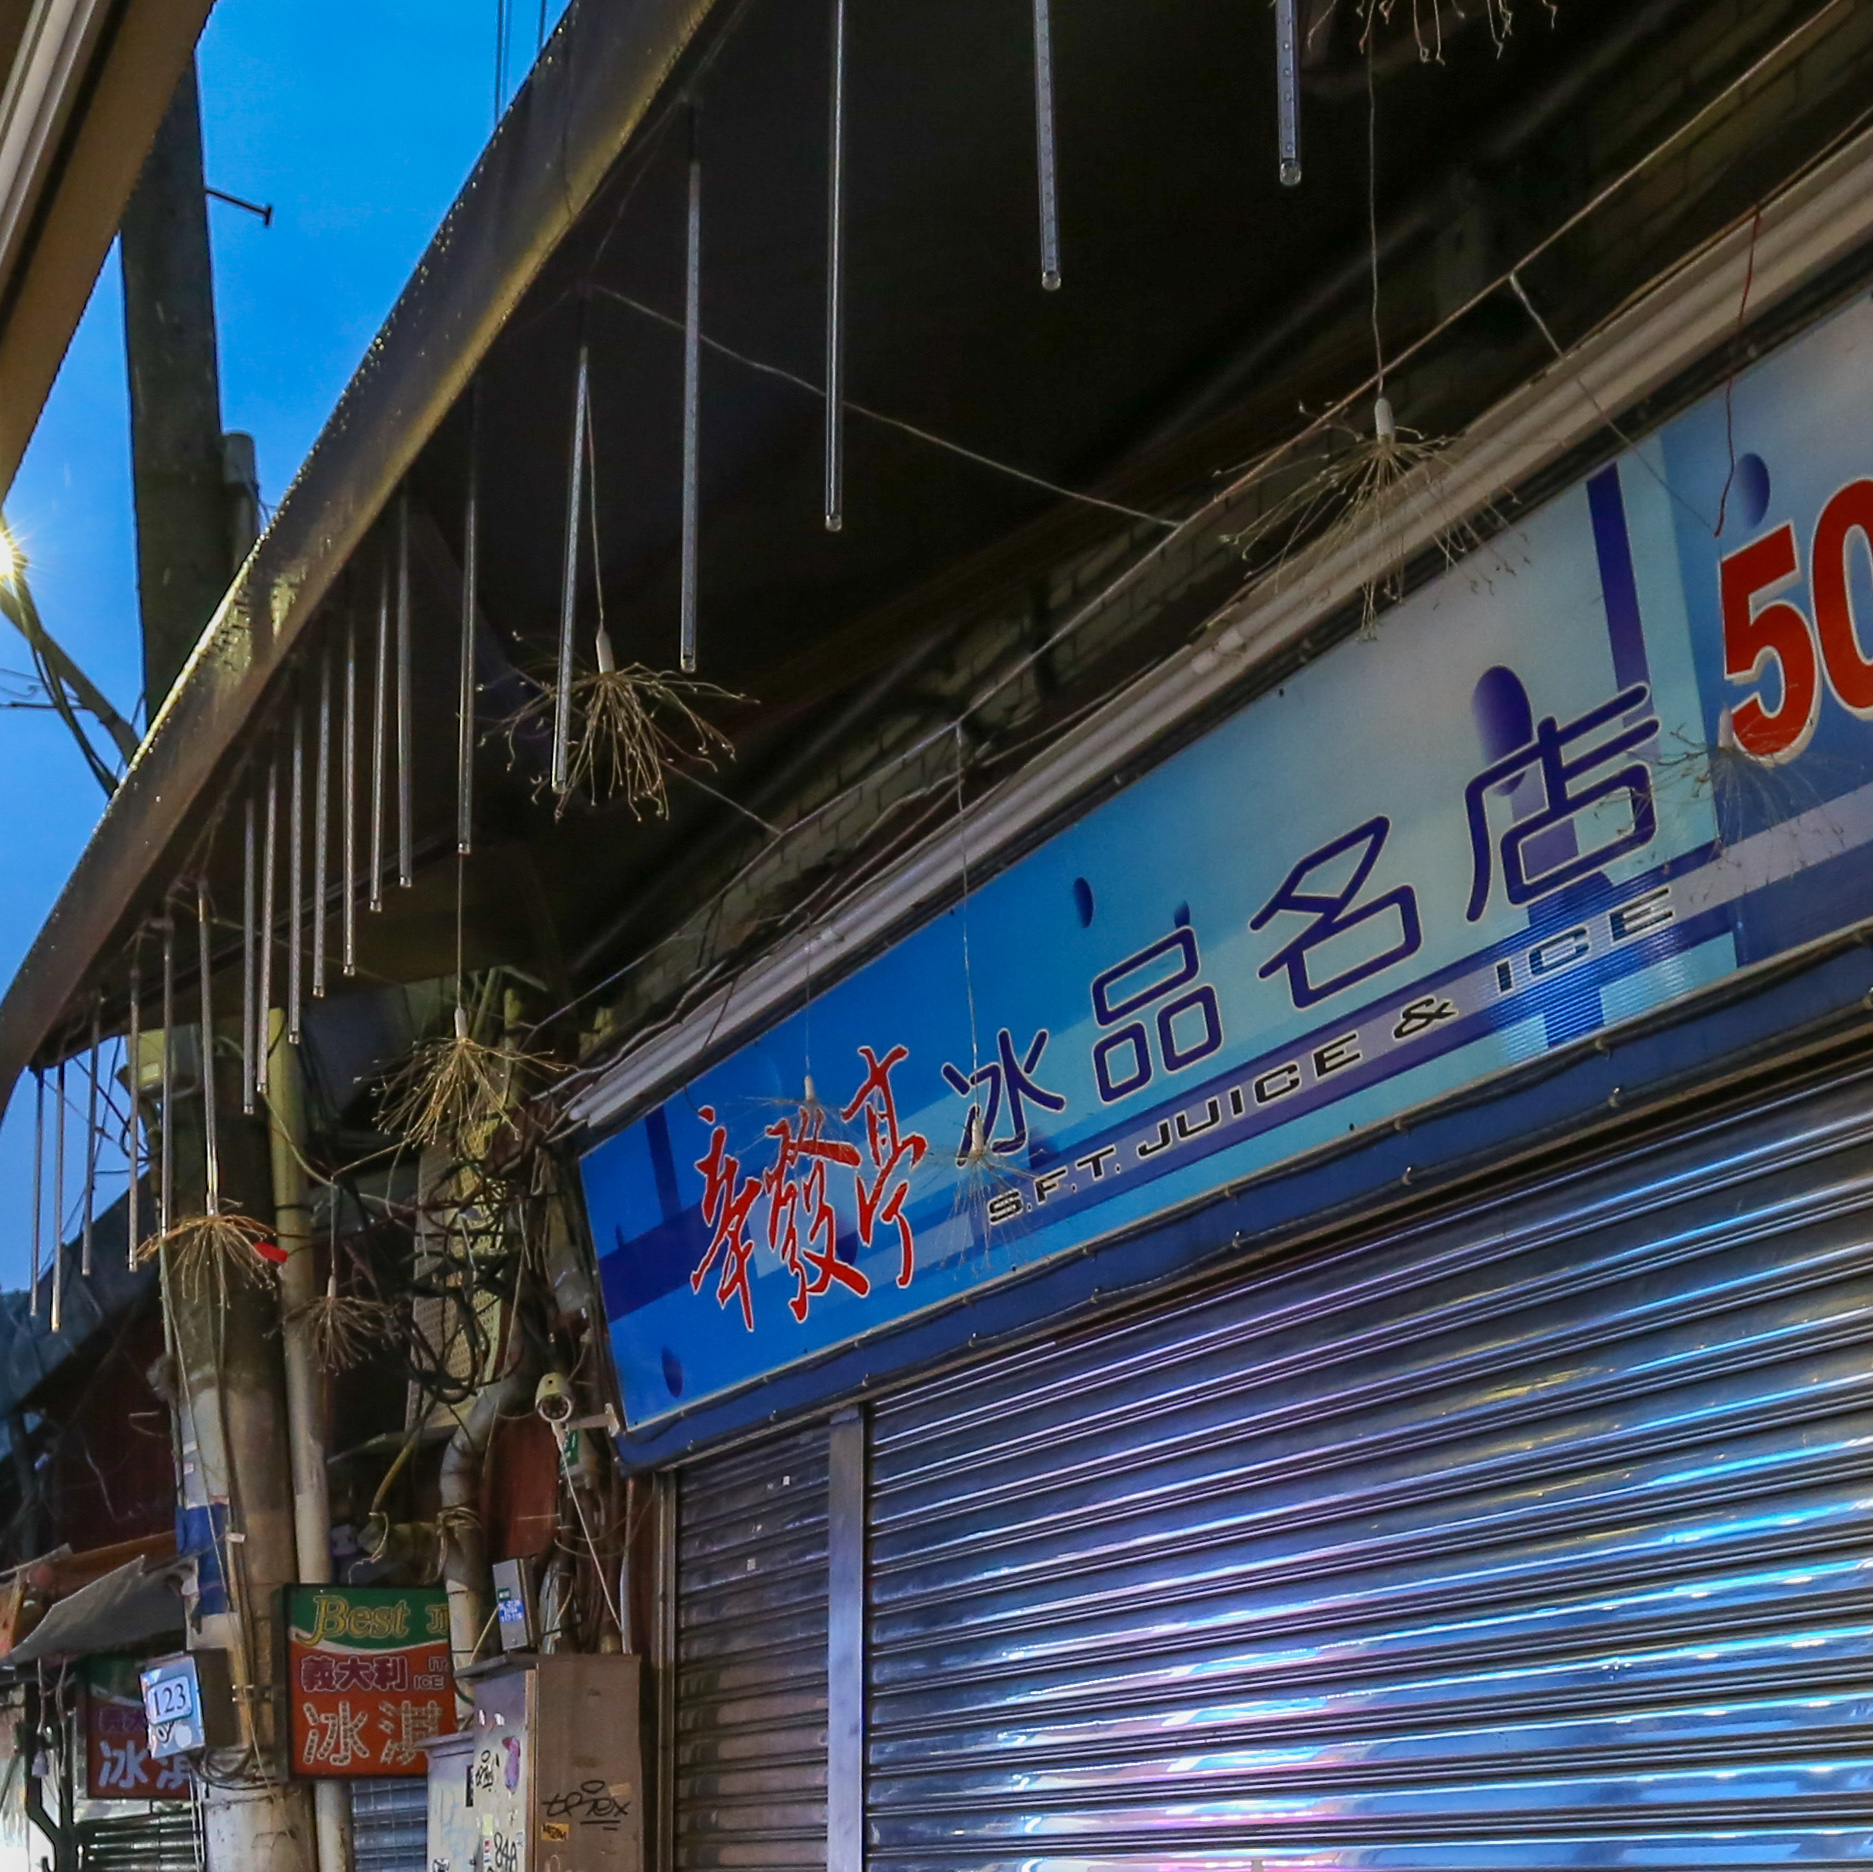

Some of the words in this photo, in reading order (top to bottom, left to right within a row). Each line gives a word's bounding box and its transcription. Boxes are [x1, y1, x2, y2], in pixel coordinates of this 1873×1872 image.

[941, 683, 1661, 1167] 冰品名店
[1137, 1033, 1361, 1160] JUICE
[1393, 996, 1460, 1041] &
[1494, 886, 1675, 994] ICE
[296, 1595, 411, 1647] Best
[301, 1655, 407, 1692] 義大利
[413, 1674, 445, 1690] ICE
[153, 1683, 187, 1716] 123
